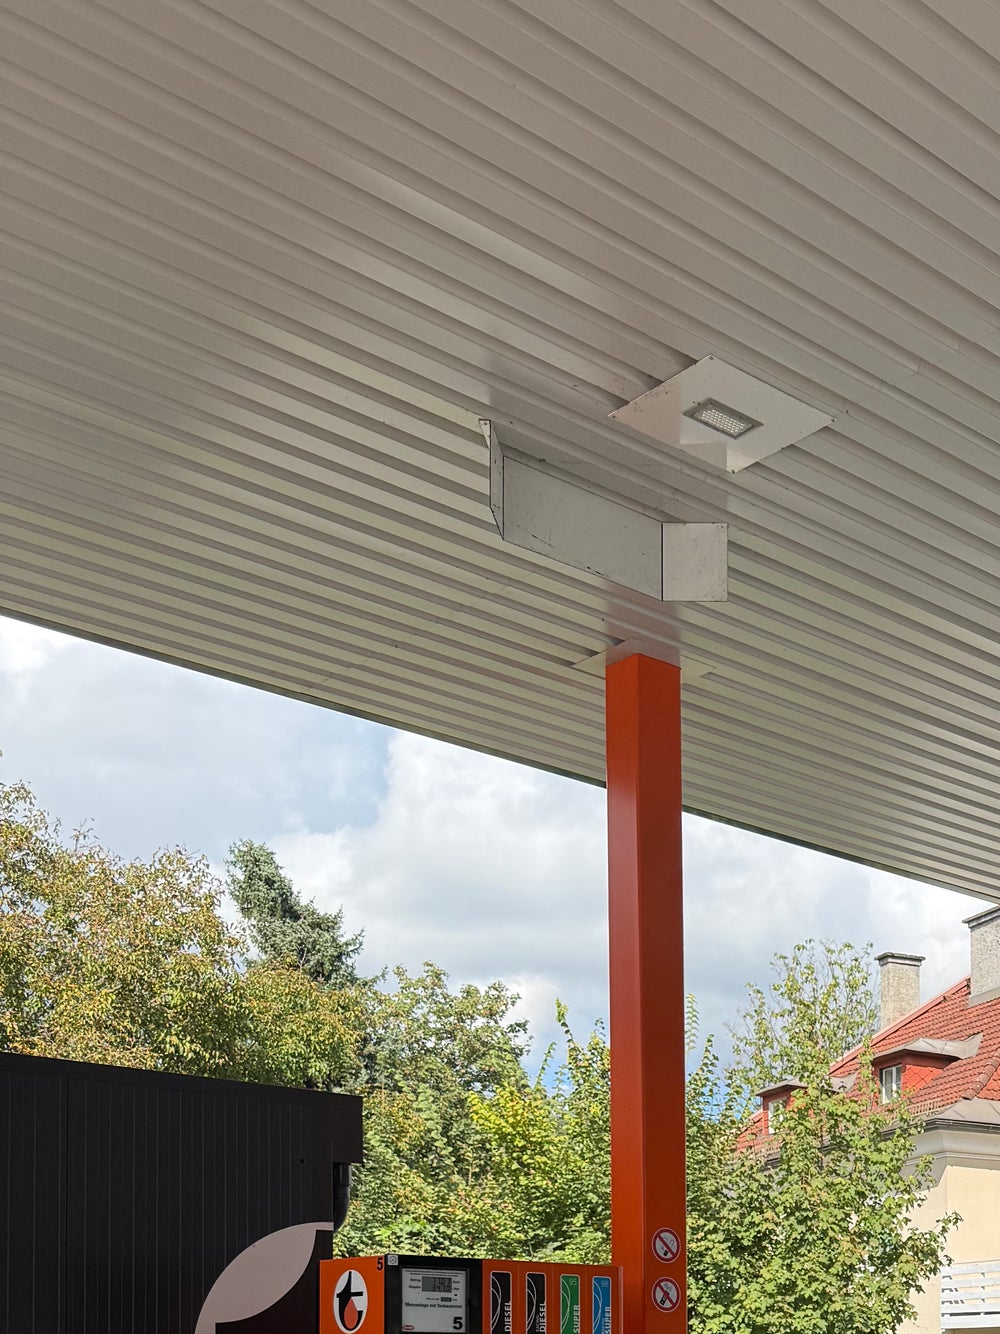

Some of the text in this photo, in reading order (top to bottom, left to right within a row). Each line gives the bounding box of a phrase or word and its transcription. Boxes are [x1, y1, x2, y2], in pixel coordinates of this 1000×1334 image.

[377, 1257, 383, 1271] 5
[569, 1278, 577, 1286] 95
[452, 1316, 463, 1330] 5
